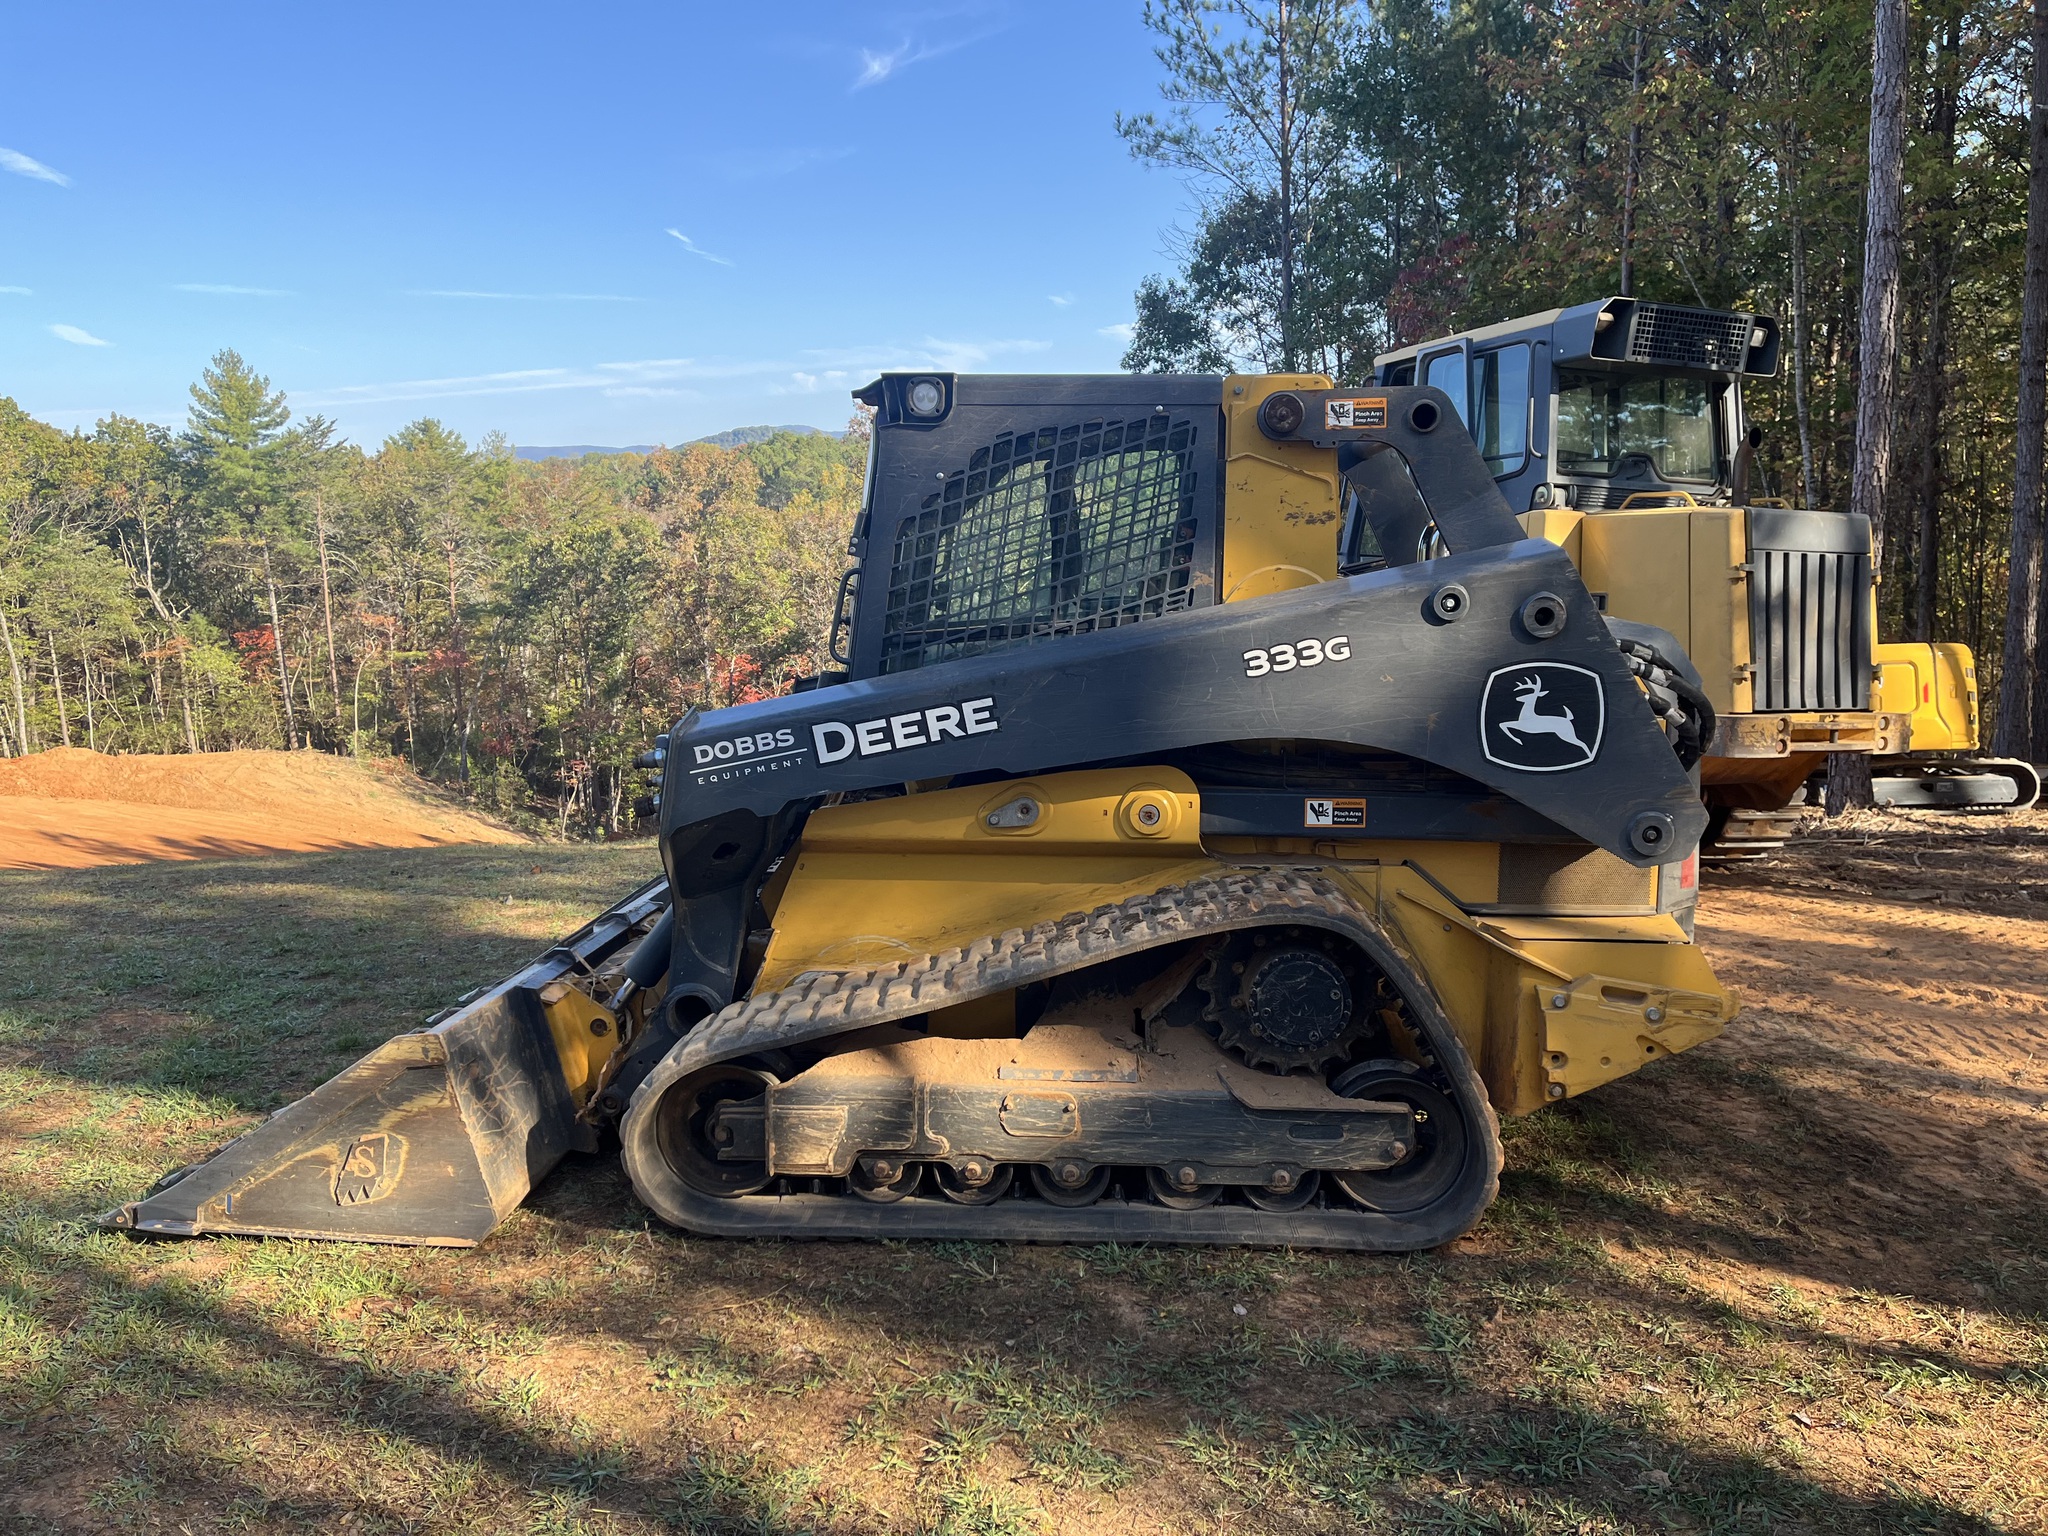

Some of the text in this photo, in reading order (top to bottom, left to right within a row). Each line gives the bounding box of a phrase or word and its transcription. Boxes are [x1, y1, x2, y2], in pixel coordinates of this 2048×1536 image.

[1243, 635, 1352, 678] 333G
[693, 728, 795, 764] DOBBS
[811, 697, 998, 764] DEERE
[698, 757, 803, 785] EQUIPMENT
